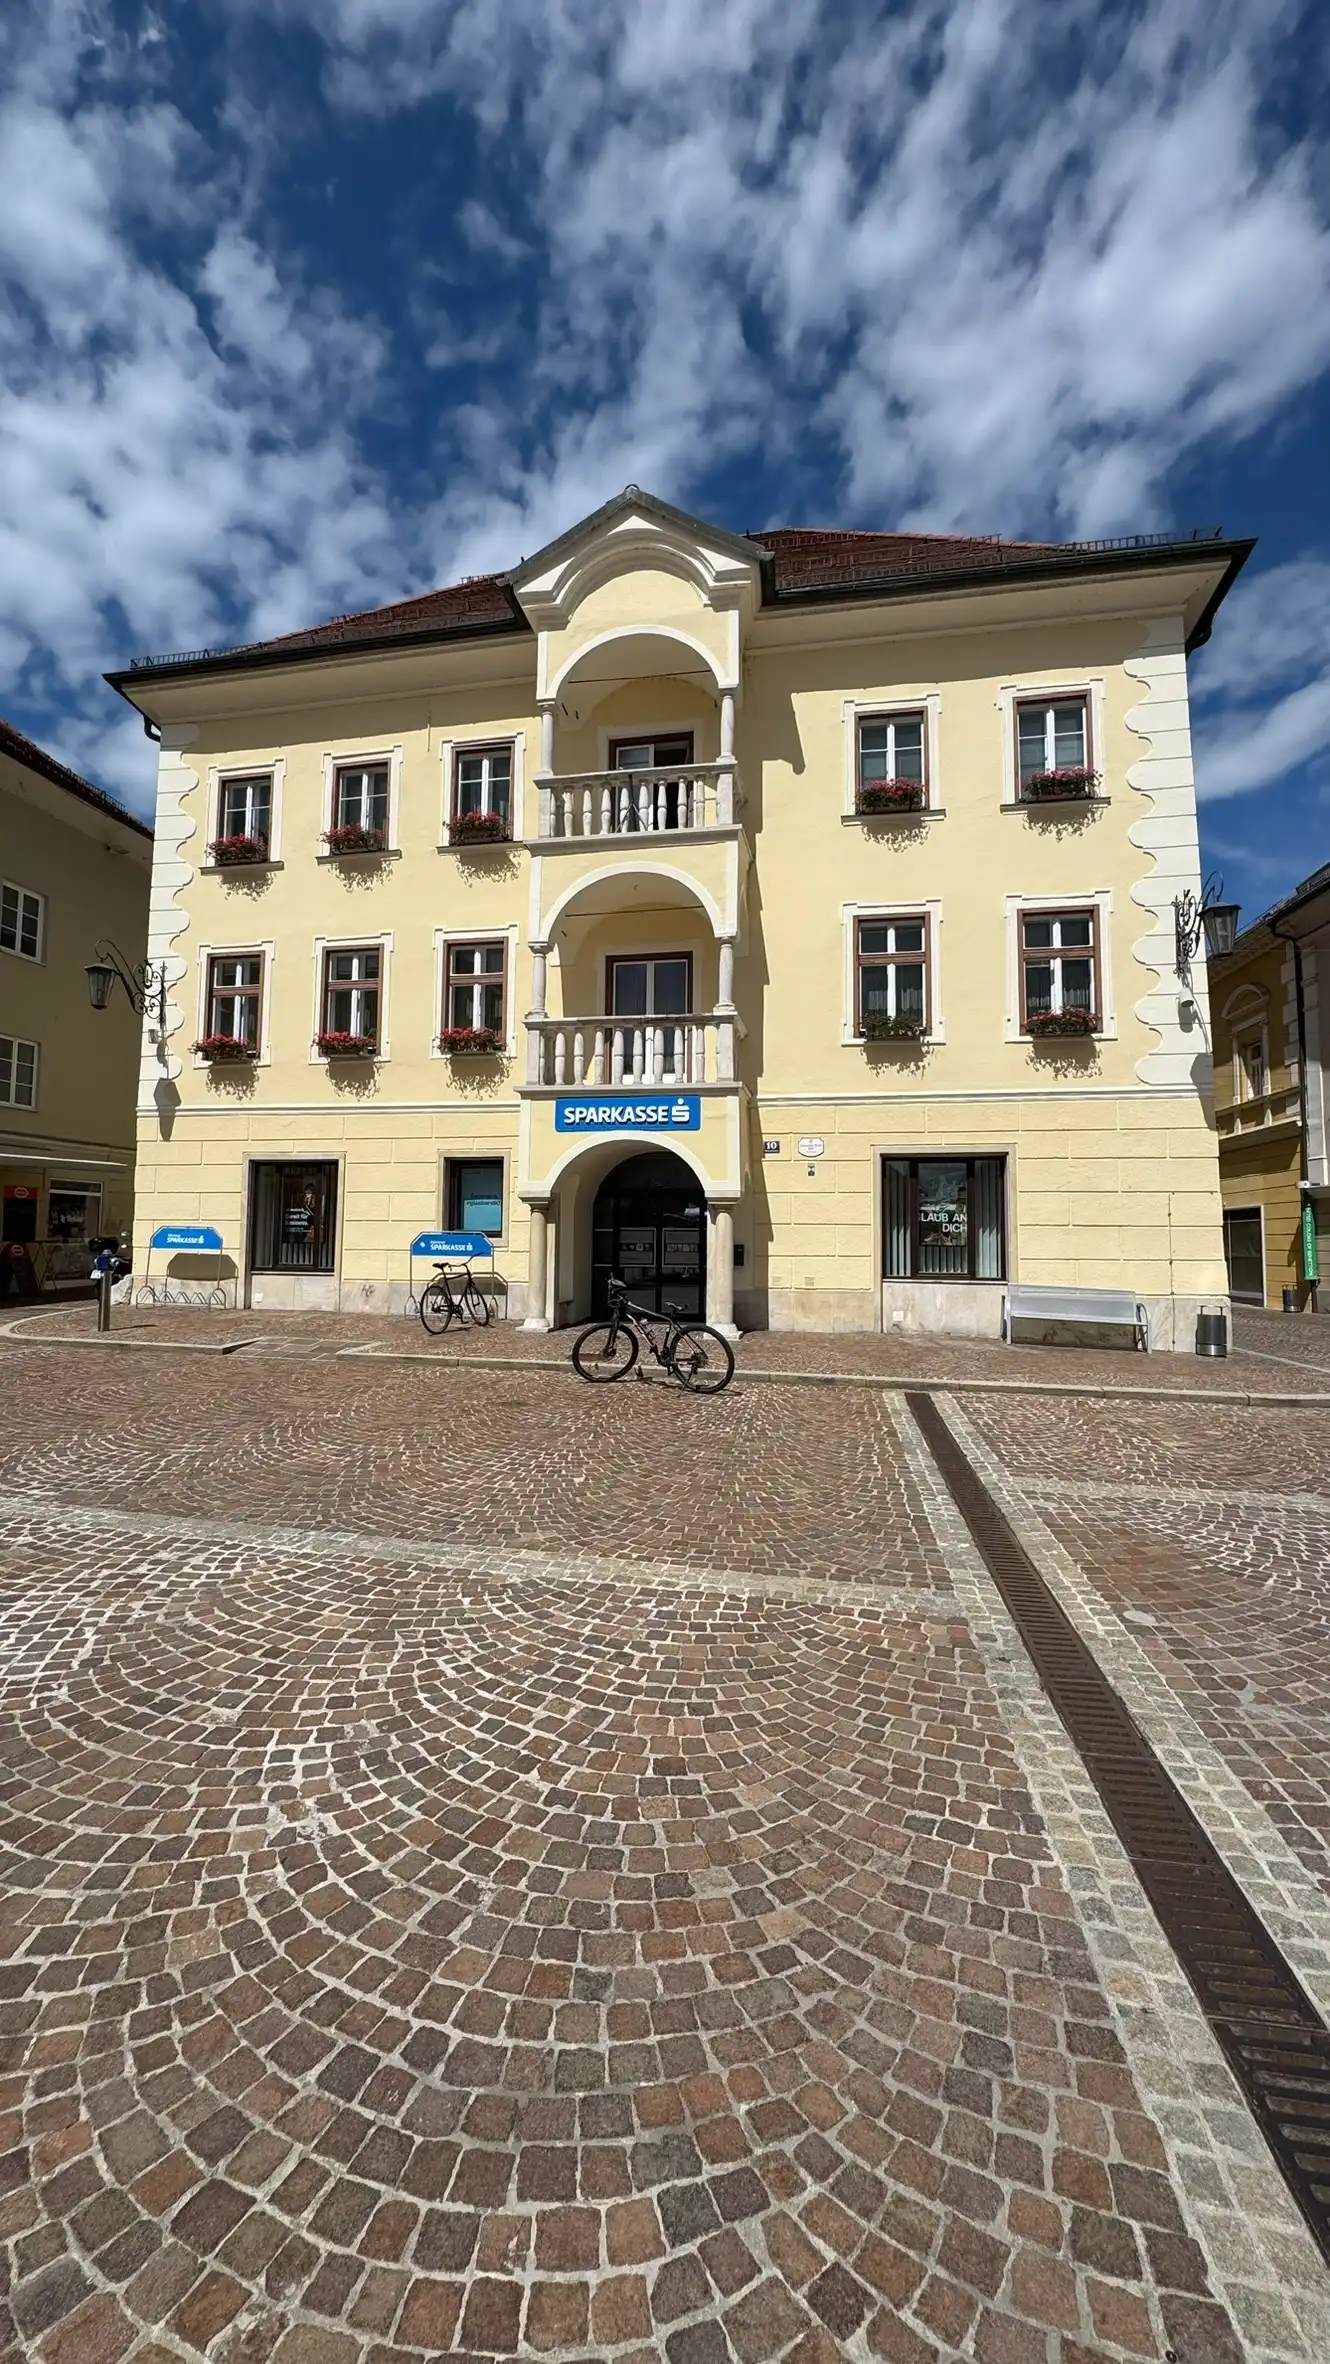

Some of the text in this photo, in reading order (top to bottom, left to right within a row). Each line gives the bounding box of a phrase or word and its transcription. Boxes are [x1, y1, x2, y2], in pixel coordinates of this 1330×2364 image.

[564, 1106, 669, 1124] SPARKASSE
[766, 1141, 777, 1150] 10
[918, 1213, 948, 1222] LAUB
[943, 1223, 967, 1233] DICH
